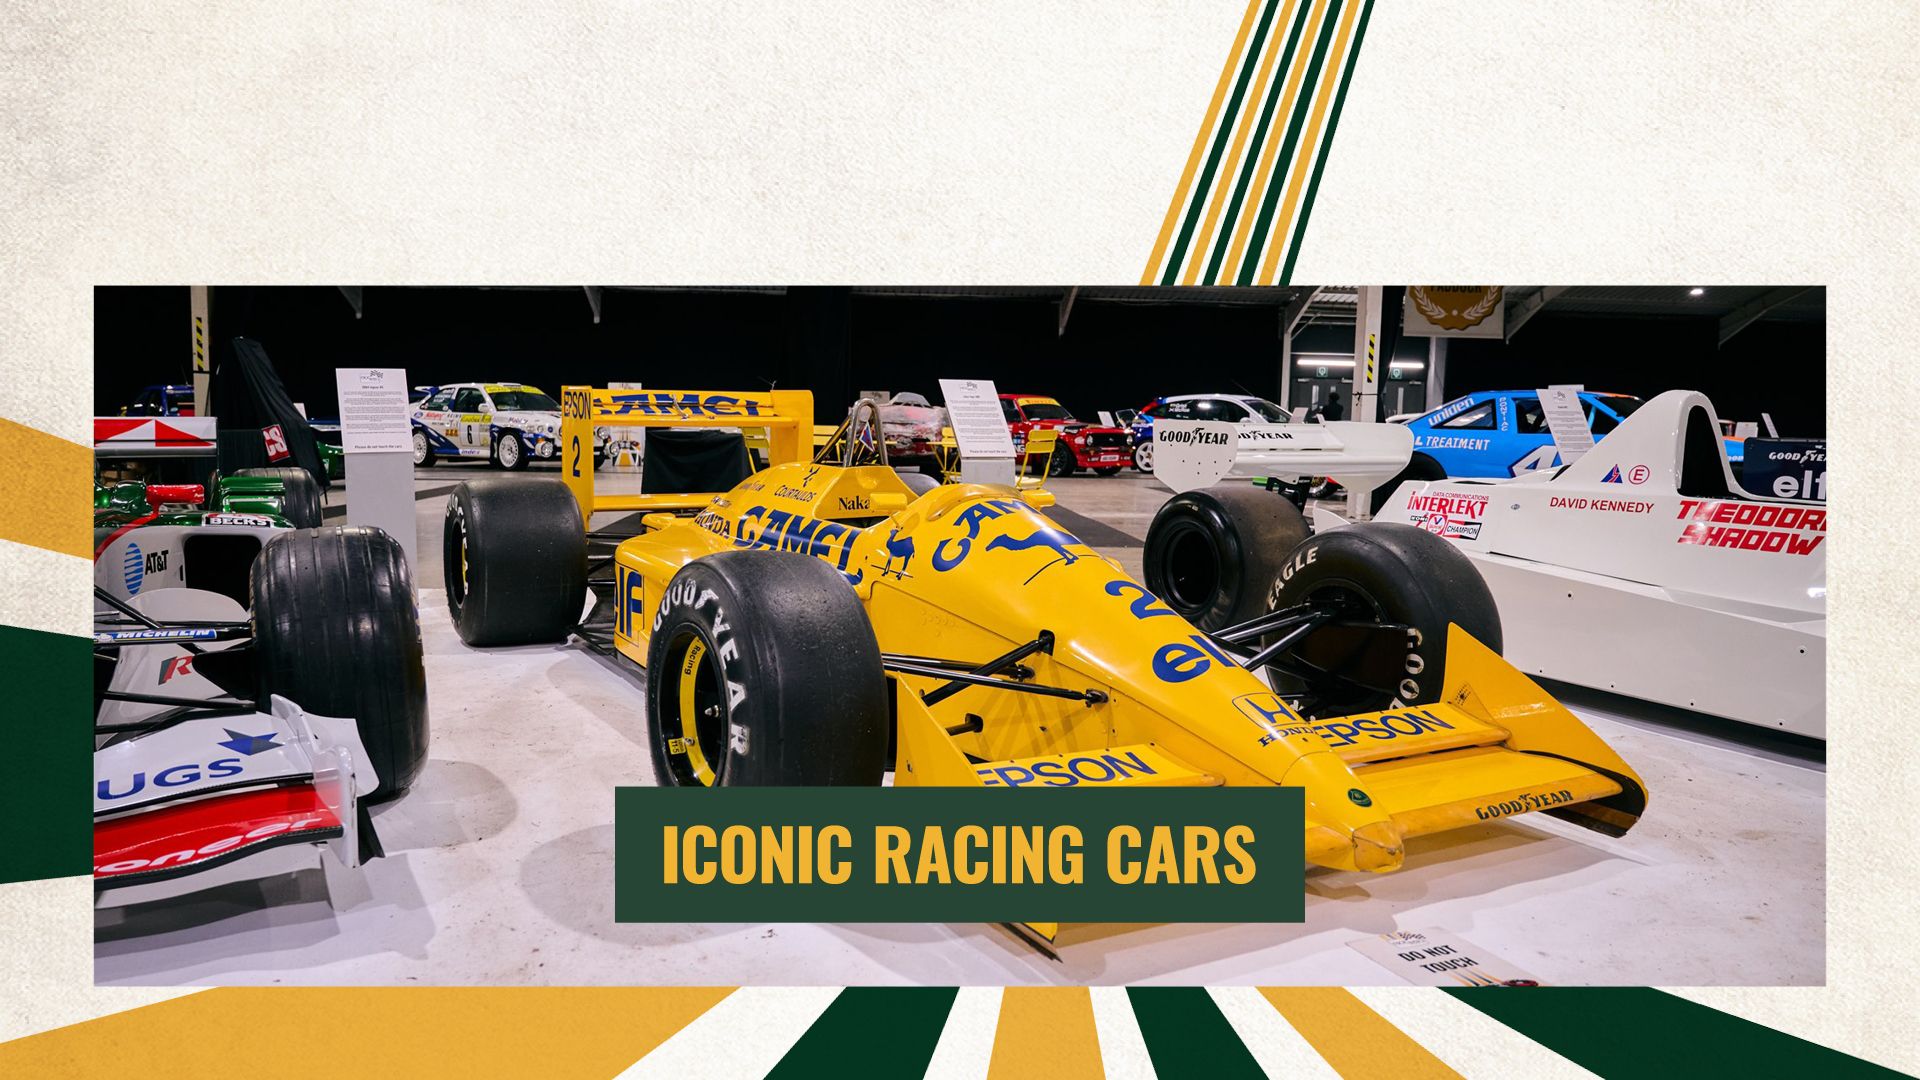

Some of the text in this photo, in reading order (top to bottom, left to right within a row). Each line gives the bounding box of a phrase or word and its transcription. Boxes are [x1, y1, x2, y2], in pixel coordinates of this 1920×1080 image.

[563, 392, 591, 419] EPSON
[1428, 397, 1475, 426] uniden
[467, 424, 473, 445] 6
[1426, 436, 1491, 451] TREATMENT
[572, 435, 581, 477] 2
[838, 496, 872, 512] Naka
[1445, 492, 1489, 501] COMMUNICATIONS
[1550, 496, 1654, 515] DAVID KENNEDY
[1446, 525, 1477, 535] CHAMPION
[1677, 525, 1824, 556] SHADOW
[733, 505, 863, 586] CAMEL
[144, 550, 169, 576] AT&T
[1267, 546, 1319, 610] EAGLE
[1104, 580, 1179, 620] 2
[116, 629, 209, 638] MICHELIN
[97, 757, 244, 800] UGS
[1398, 945, 1458, 962] DO NOT
[1420, 957, 1479, 973] TOUCH
